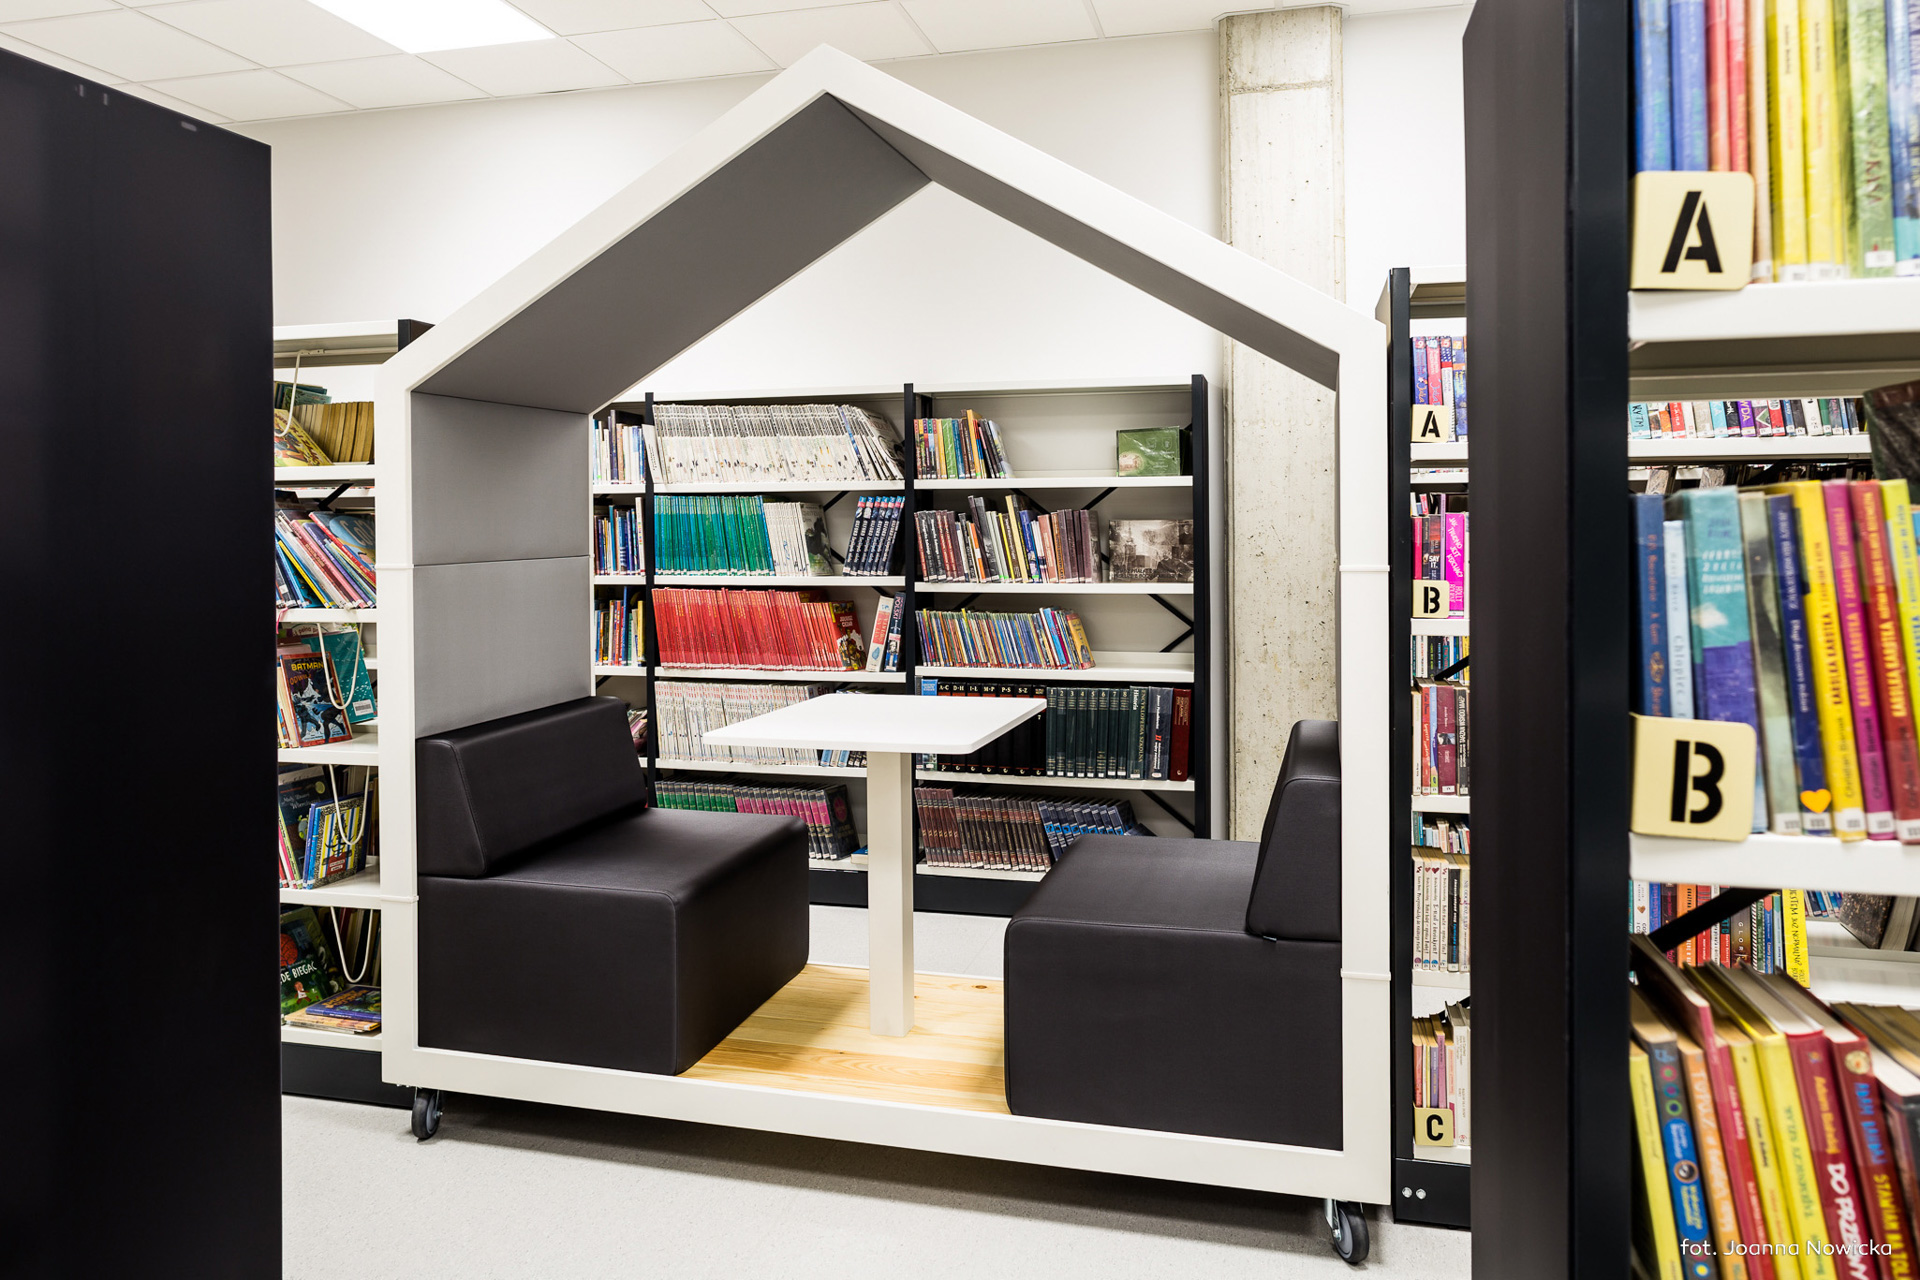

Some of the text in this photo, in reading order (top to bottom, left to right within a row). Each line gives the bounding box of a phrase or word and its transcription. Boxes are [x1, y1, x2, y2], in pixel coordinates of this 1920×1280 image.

[1661, 191, 1723, 273] A
[1421, 410, 1440, 437] A
[1423, 586, 1441, 613] B
[291, 662, 324, 671] BATMAN
[1671, 739, 1724, 824] B
[1426, 1114, 1444, 1142] C
[1827, 1163, 1850, 1195] DO
[1873, 1174, 1901, 1231] STAWIAM
[1886, 1234, 1905, 1250] NA
